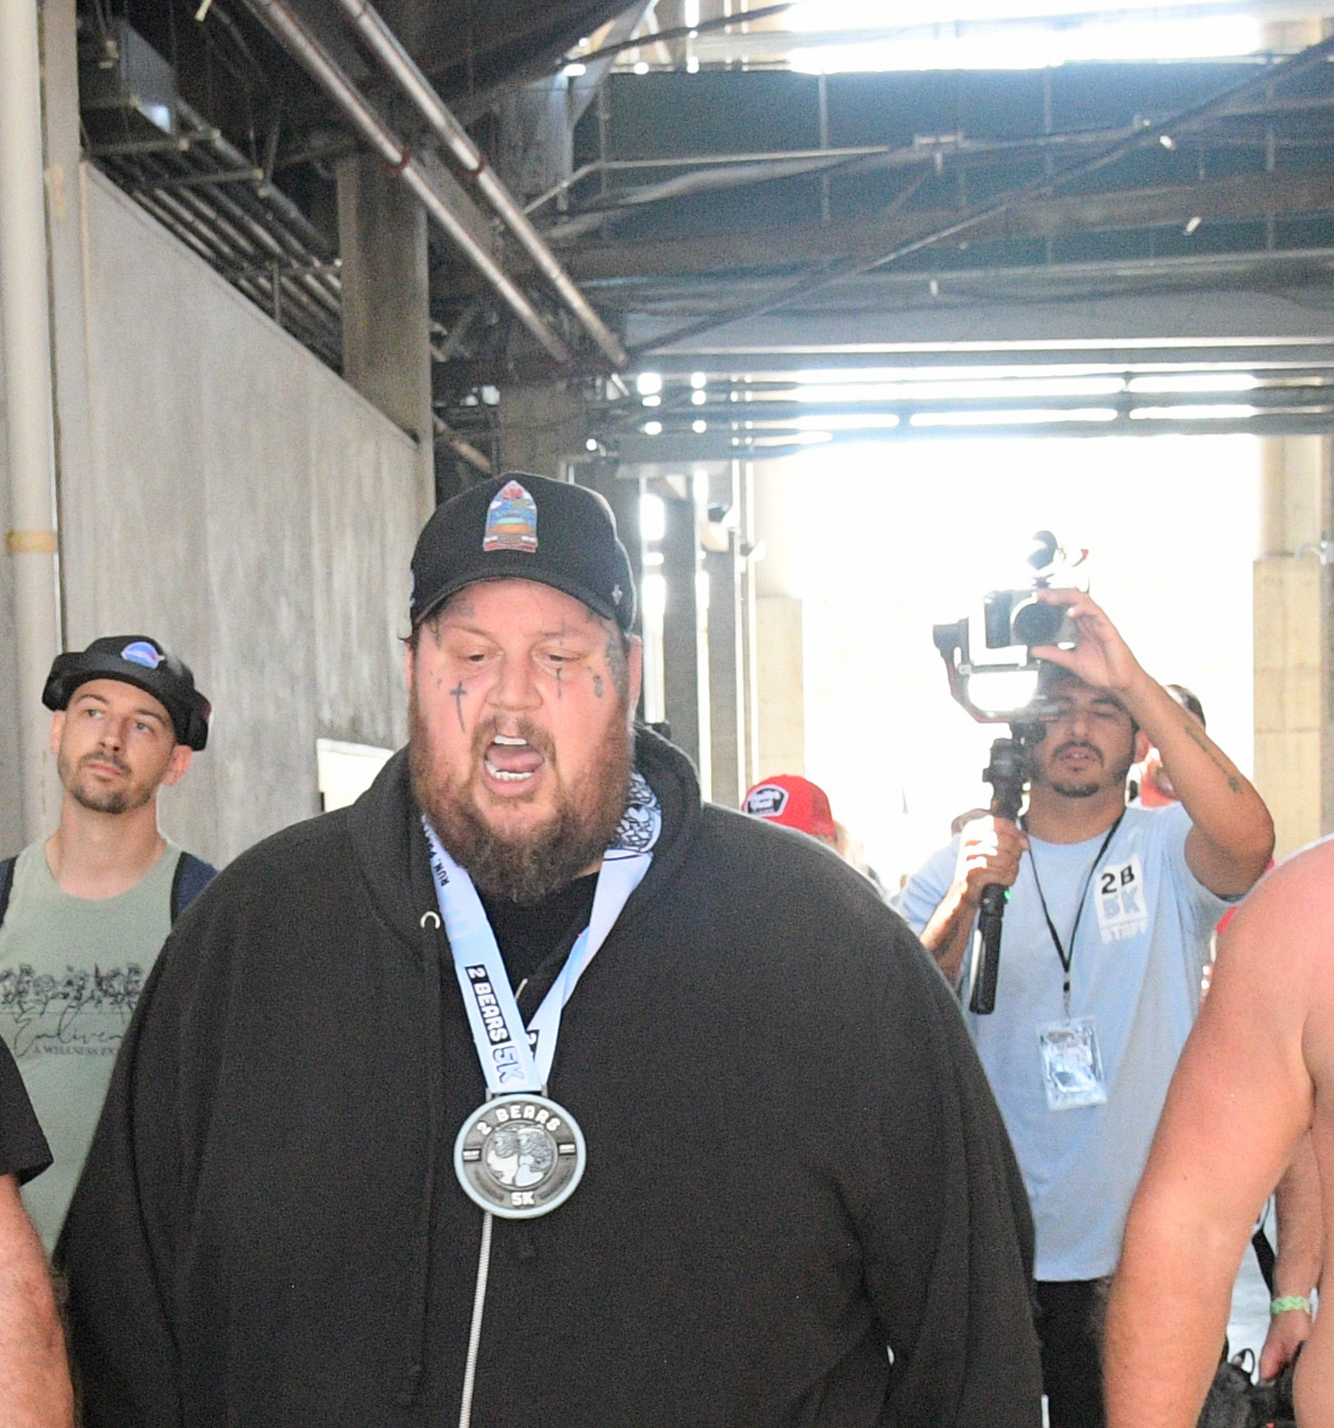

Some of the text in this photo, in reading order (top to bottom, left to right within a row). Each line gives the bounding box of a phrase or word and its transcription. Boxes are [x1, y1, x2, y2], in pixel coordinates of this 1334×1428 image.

[467, 967, 508, 1043] 2 BEARS
[492, 1044, 525, 1085] 5K
[476, 1104, 561, 1136] 2 BEARS
[510, 1191, 536, 1207] 5K
